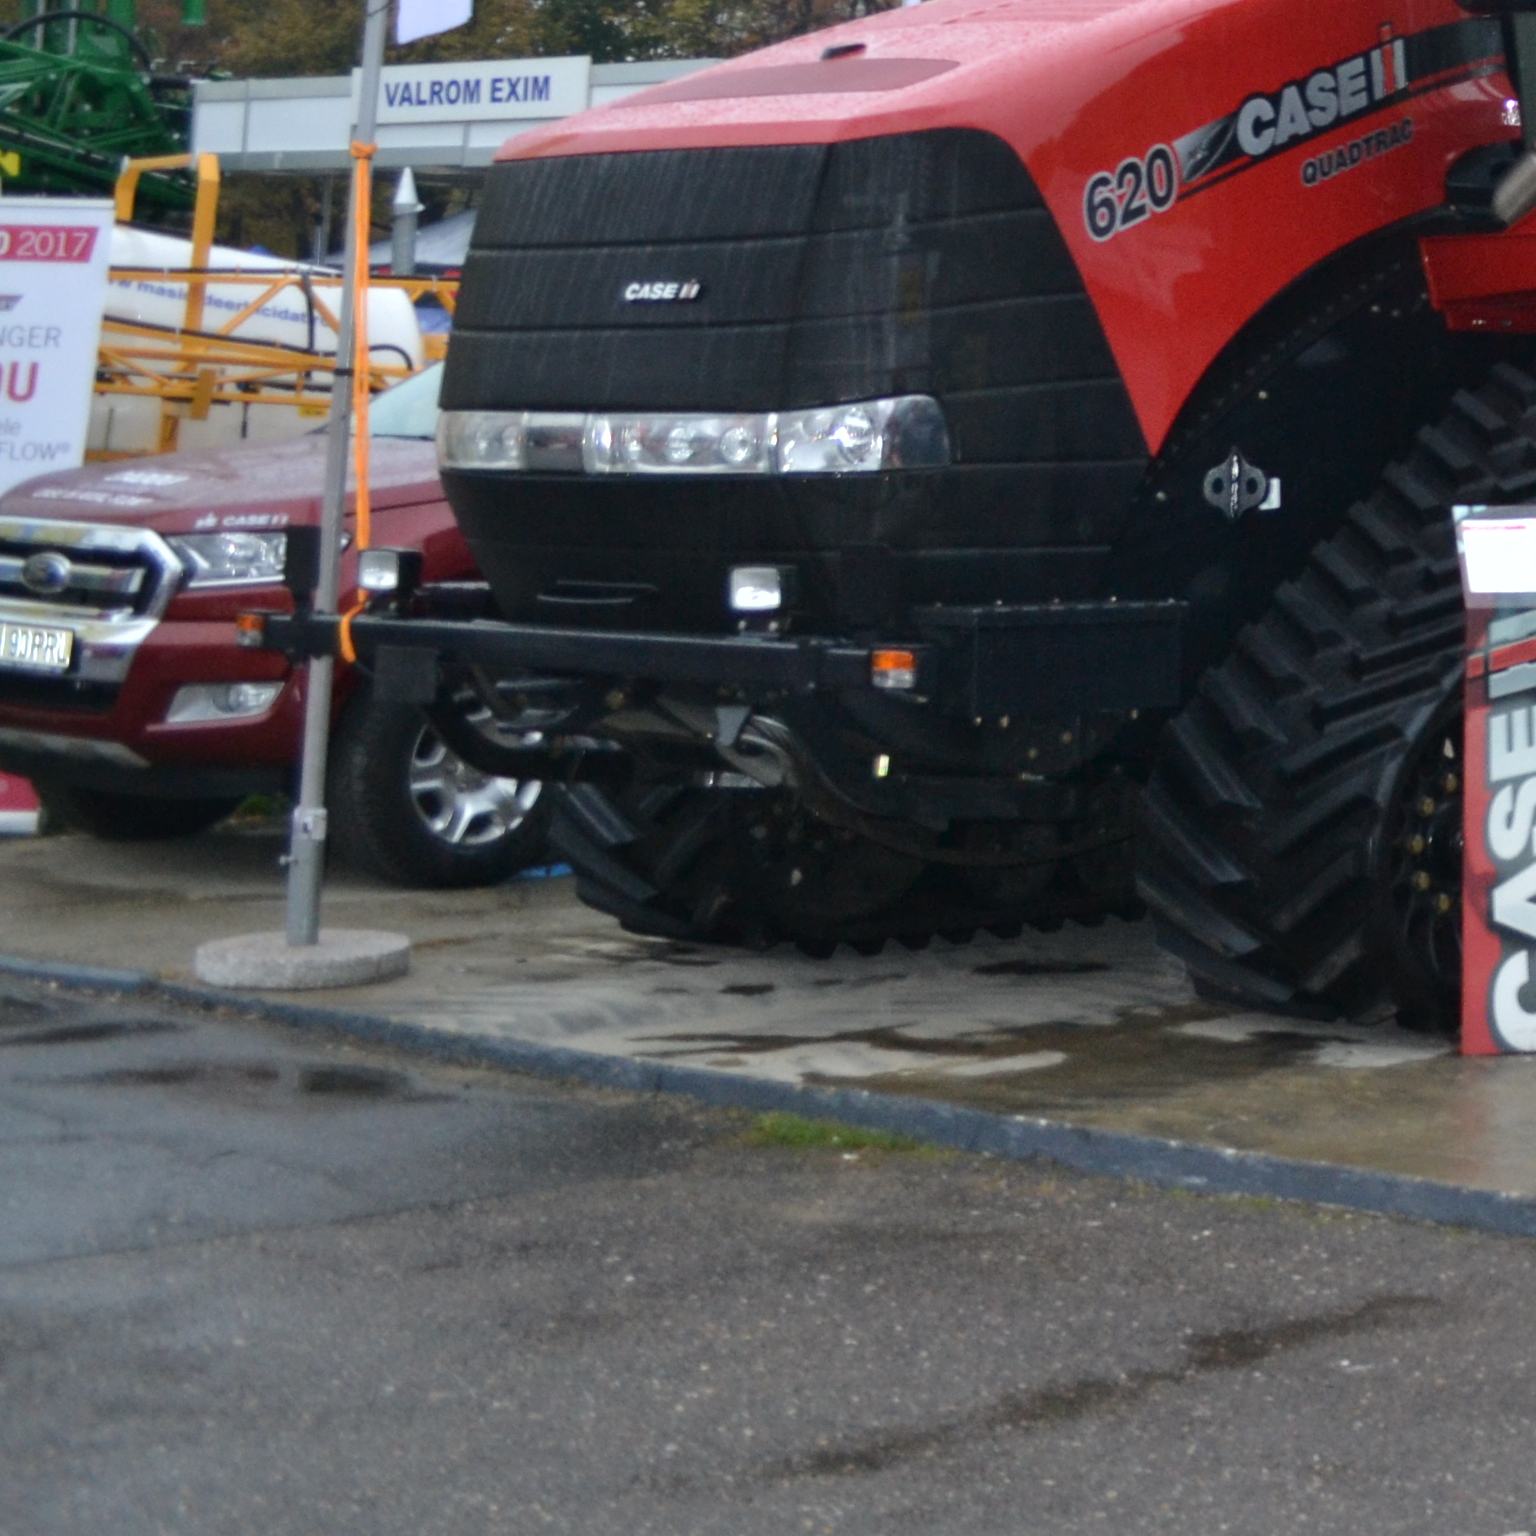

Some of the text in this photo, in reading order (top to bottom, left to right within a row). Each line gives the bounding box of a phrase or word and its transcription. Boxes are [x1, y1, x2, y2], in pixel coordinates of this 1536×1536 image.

[384, 75, 551, 107] VALROM EXIM
[1236, 56, 1369, 156] CASE
[1301, 117, 1416, 188] QUADTRAC
[1084, 144, 1179, 243] 620
[16, 231, 89, 257] 2017
[625, 282, 680, 301] CASE
